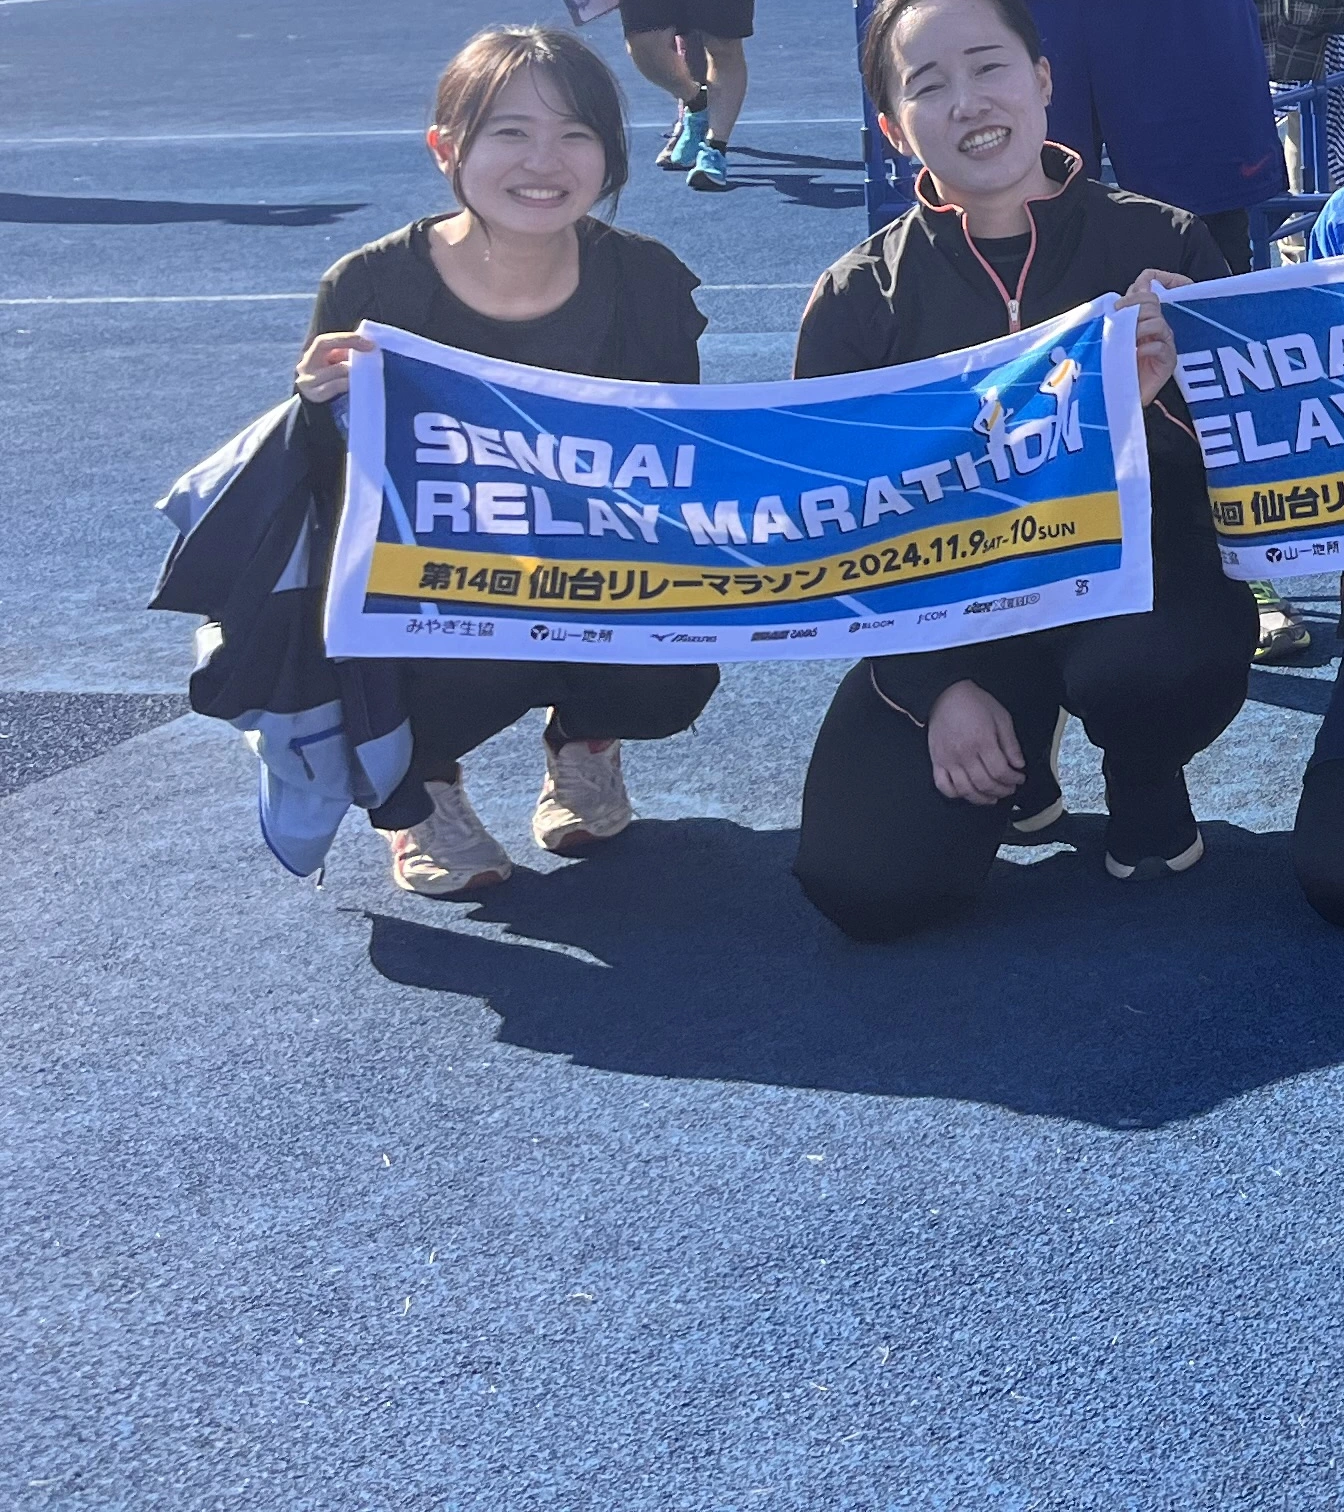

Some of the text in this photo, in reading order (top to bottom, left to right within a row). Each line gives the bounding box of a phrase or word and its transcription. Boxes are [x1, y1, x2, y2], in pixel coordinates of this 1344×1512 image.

[413, 413, 697, 487] SENDAI
[413, 401, 1084, 548] RELAY MARATHON
[1284, 540, 1340, 560] 山一地所
[419, 562, 521, 597] 第14回
[528, 564, 827, 601] 仙台リレーマラソン
[406, 619, 495, 636] みやぎ生協
[551, 628, 613, 643] 山一地所
